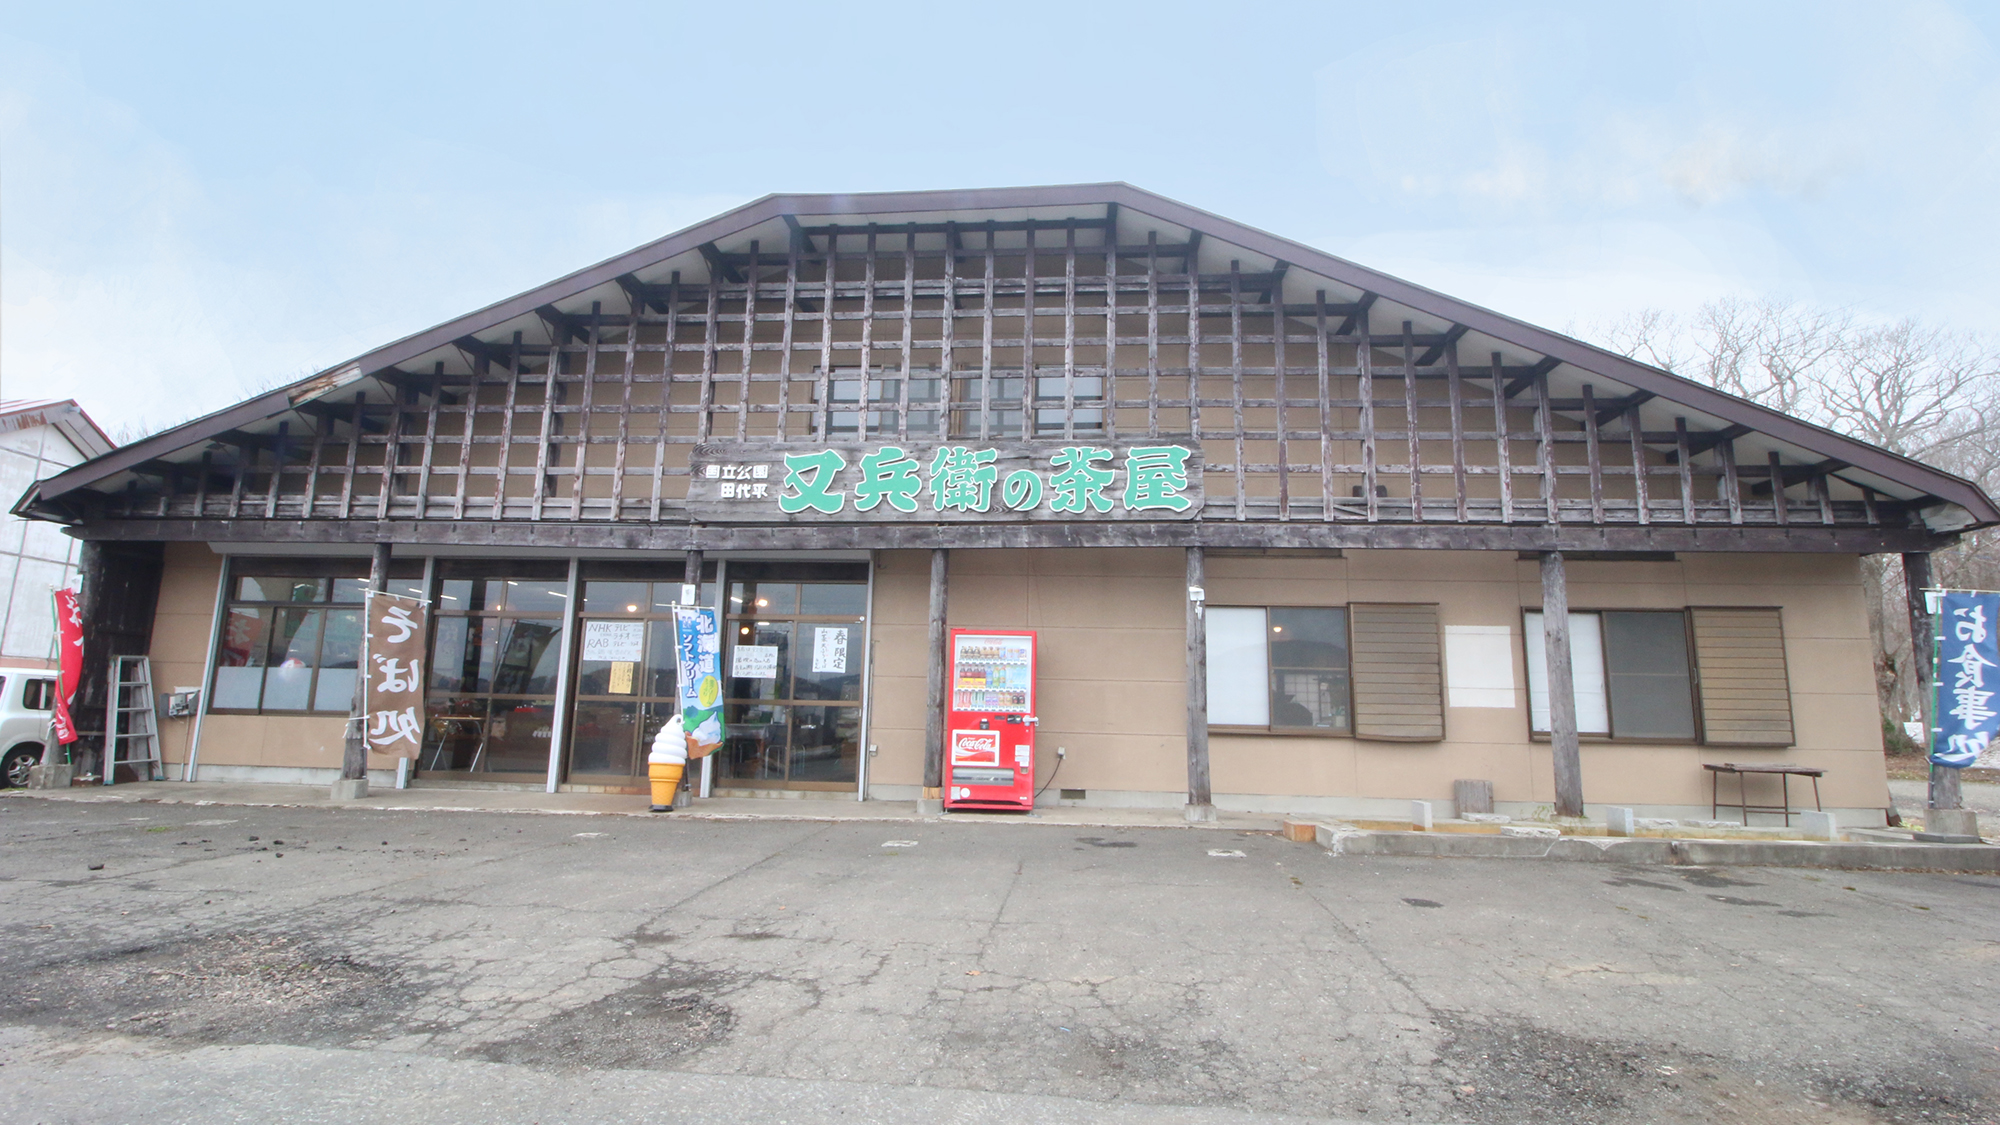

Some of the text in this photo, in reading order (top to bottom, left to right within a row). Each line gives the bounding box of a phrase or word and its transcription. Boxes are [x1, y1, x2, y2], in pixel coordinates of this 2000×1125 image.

[706, 465, 768, 480] 国立公園
[779, 446, 1192, 514] 又兵衛の茶屋
[721, 483, 768, 499] 田代平
[588, 624, 612, 633] NHK
[586, 638, 609, 648] RAB
[696, 615, 716, 674] 北海道
[833, 629, 847, 669] 春限定
[683, 634, 698, 698] ソフトクリーム
